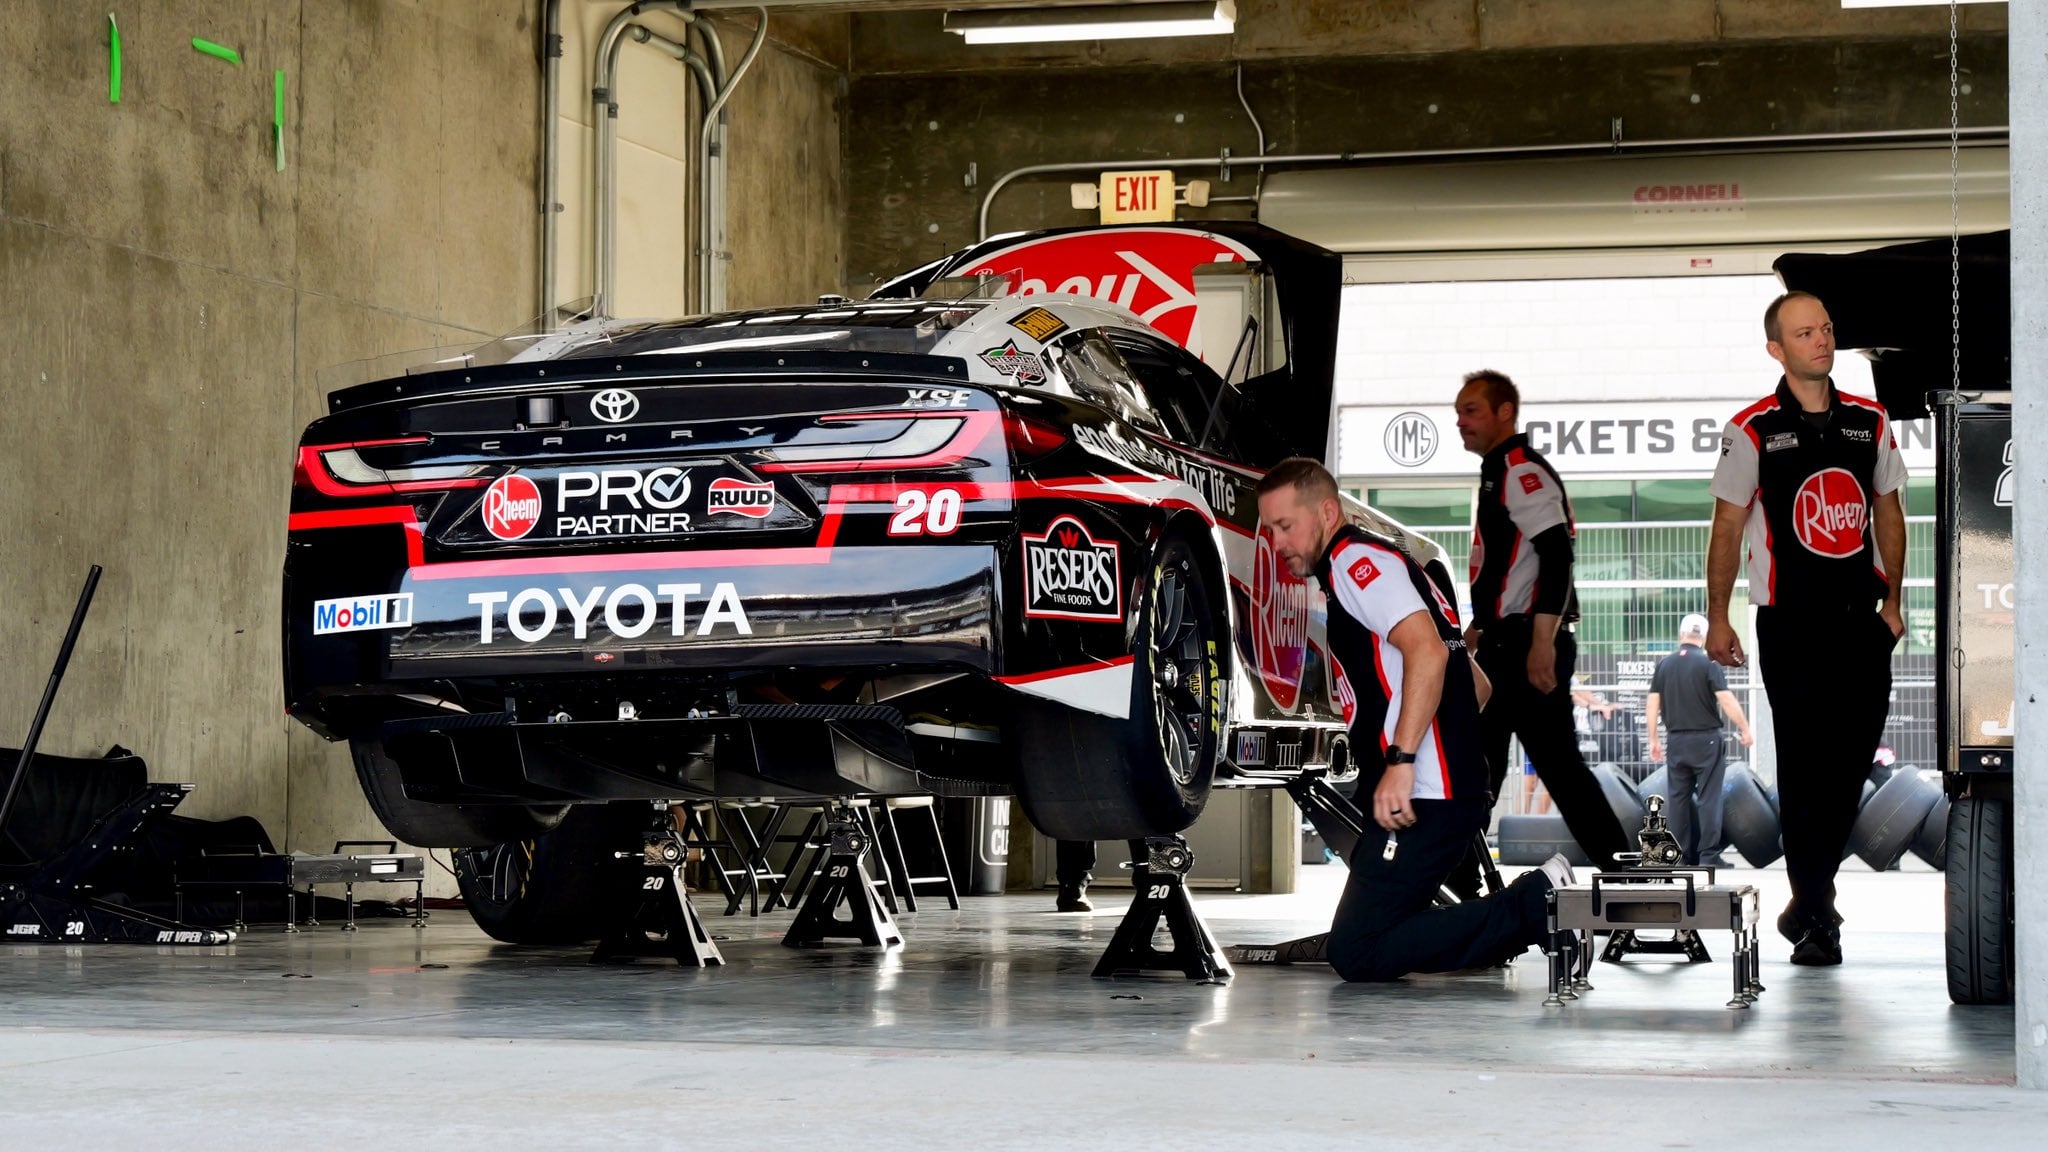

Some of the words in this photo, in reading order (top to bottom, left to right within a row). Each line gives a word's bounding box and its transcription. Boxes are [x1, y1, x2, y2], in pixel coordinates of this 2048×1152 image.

[1115, 176, 1160, 211] EXIT
[1634, 183, 1743, 203] CORNELL
[901, 389, 972, 408] XSE
[481, 426, 765, 450] CAMRY
[1394, 419, 1431, 459] IMS
[1522, 418, 1675, 456] CKETS
[557, 467, 692, 512] PRO
[709, 490, 773, 506] RUUD
[1180, 455, 1206, 493] for
[1207, 465, 1236, 517] life
[489, 476, 538, 530] Rheem
[889, 488, 962, 535] 20
[1801, 474, 1866, 545] Rheem
[1029, 546, 1114, 606] RESER'S
[467, 582, 753, 645] TOYOTA
[1053, 593, 1067, 604] FINE
[1067, 594, 1092, 606] FOODS
[1258, 532, 1307, 678] Rheem
[317, 600, 381, 631] Mobil
[1617, 661, 1655, 675] TICKETS
[1190, 673, 1201, 697] SETUP
[1206, 639, 1220, 733] EAGLE
[1238, 734, 1257, 764] Mobil
[642, 876, 665, 891] 20
[830, 865, 849, 878] 20
[1147, 884, 1171, 899] 20
[6, 924, 41, 935] JGR
[65, 921, 85, 936] 20
[156, 930, 175, 943] PIT
[174, 931, 202, 944] VIPER
